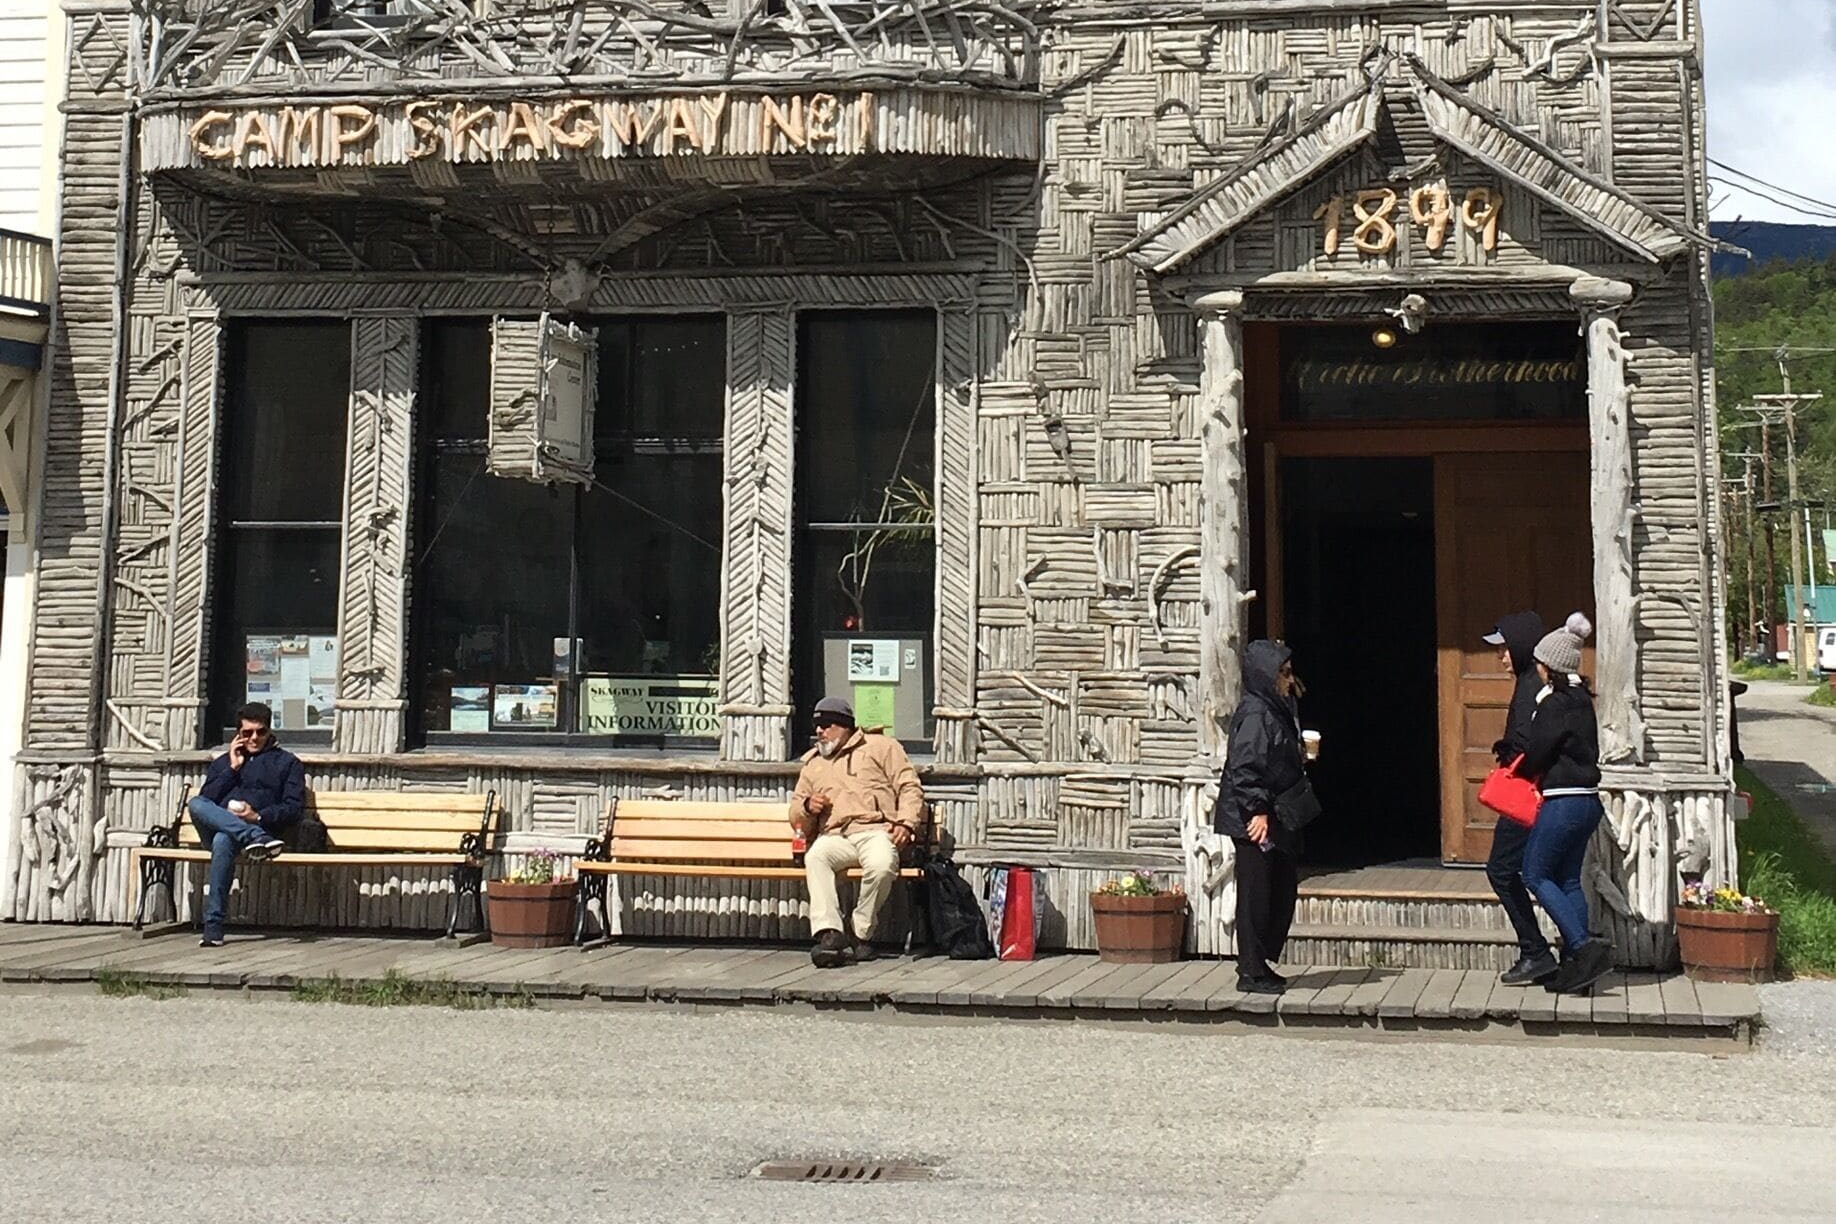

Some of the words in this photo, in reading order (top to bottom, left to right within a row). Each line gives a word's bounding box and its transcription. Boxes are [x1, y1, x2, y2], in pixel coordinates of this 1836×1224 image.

[189, 105, 376, 164] CAMP
[406, 92, 727, 160] SKAGWAY
[1312, 186, 1503, 255] 1899
[590, 687, 643, 696] SKAGWAY
